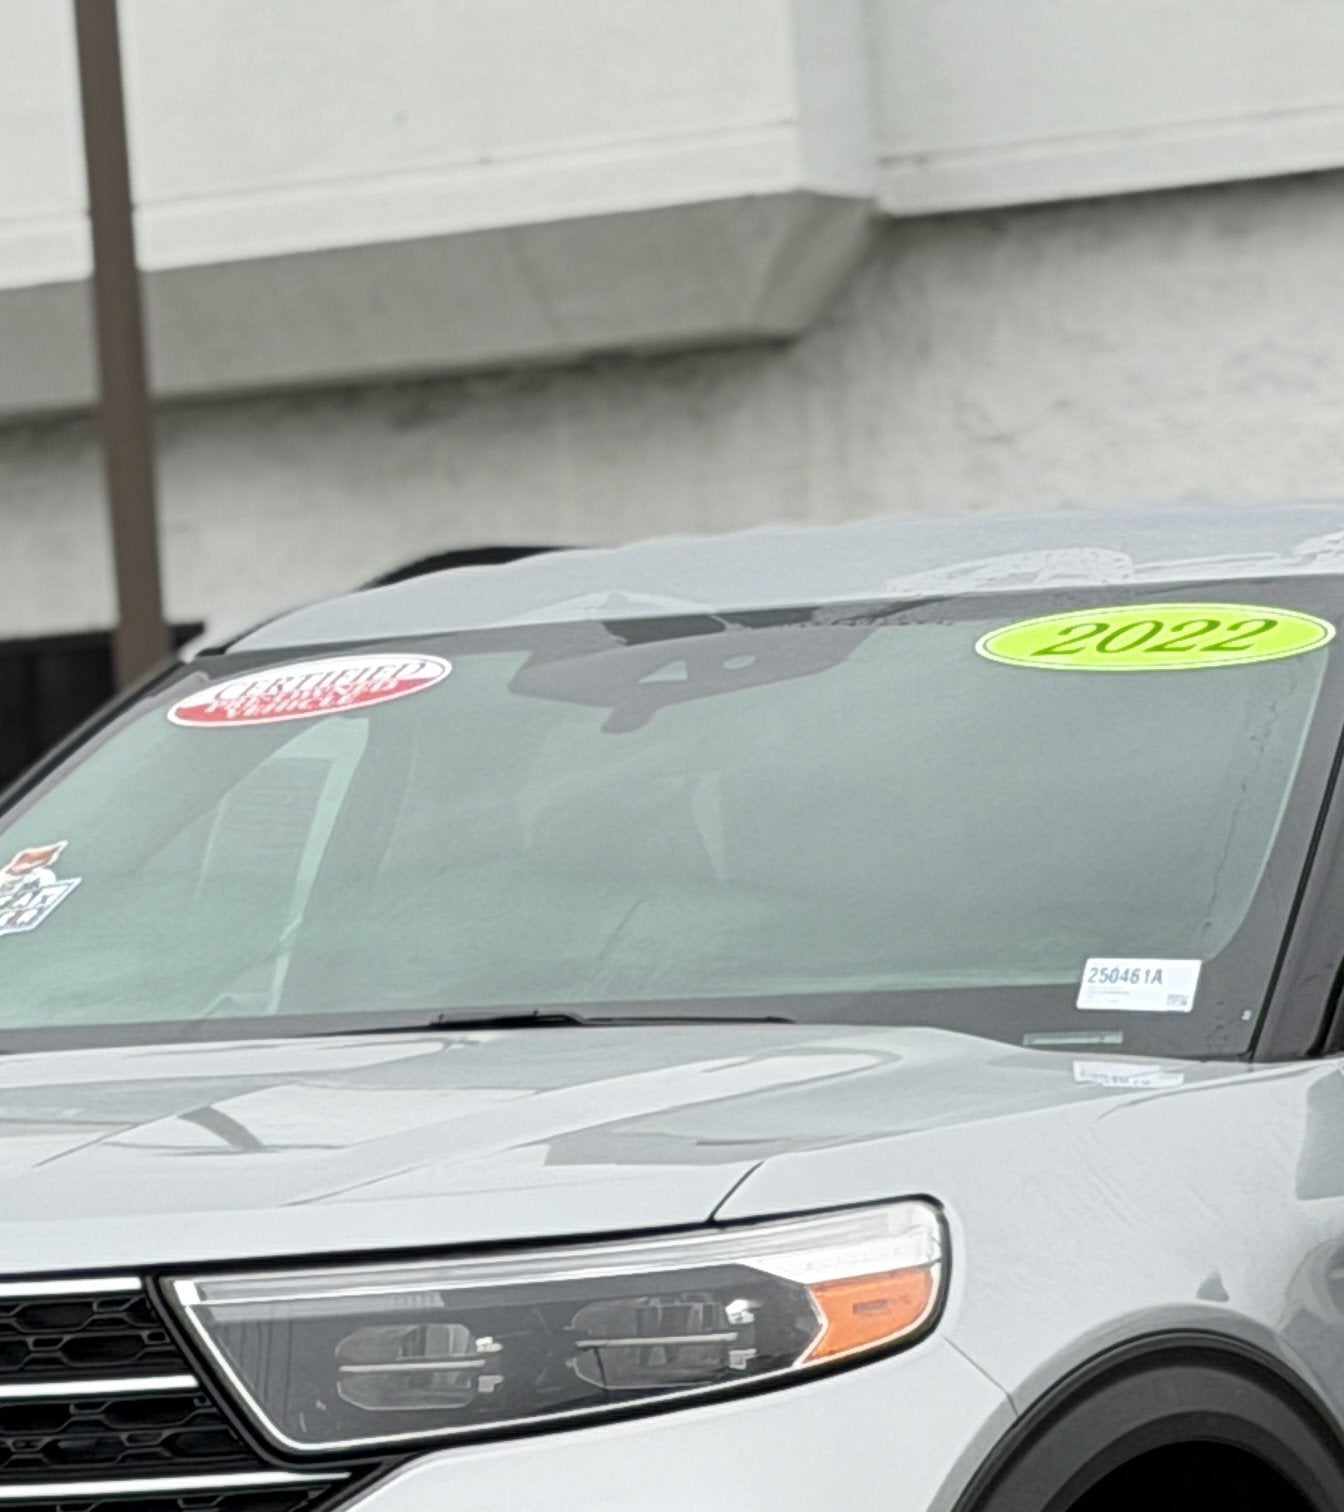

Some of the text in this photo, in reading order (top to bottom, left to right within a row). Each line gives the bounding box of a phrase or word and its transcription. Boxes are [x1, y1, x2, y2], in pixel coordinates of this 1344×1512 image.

[1031, 618, 1278, 656] 2022
[214, 662, 426, 700] CERTIFIED
[1088, 967, 1164, 985] 250461A
